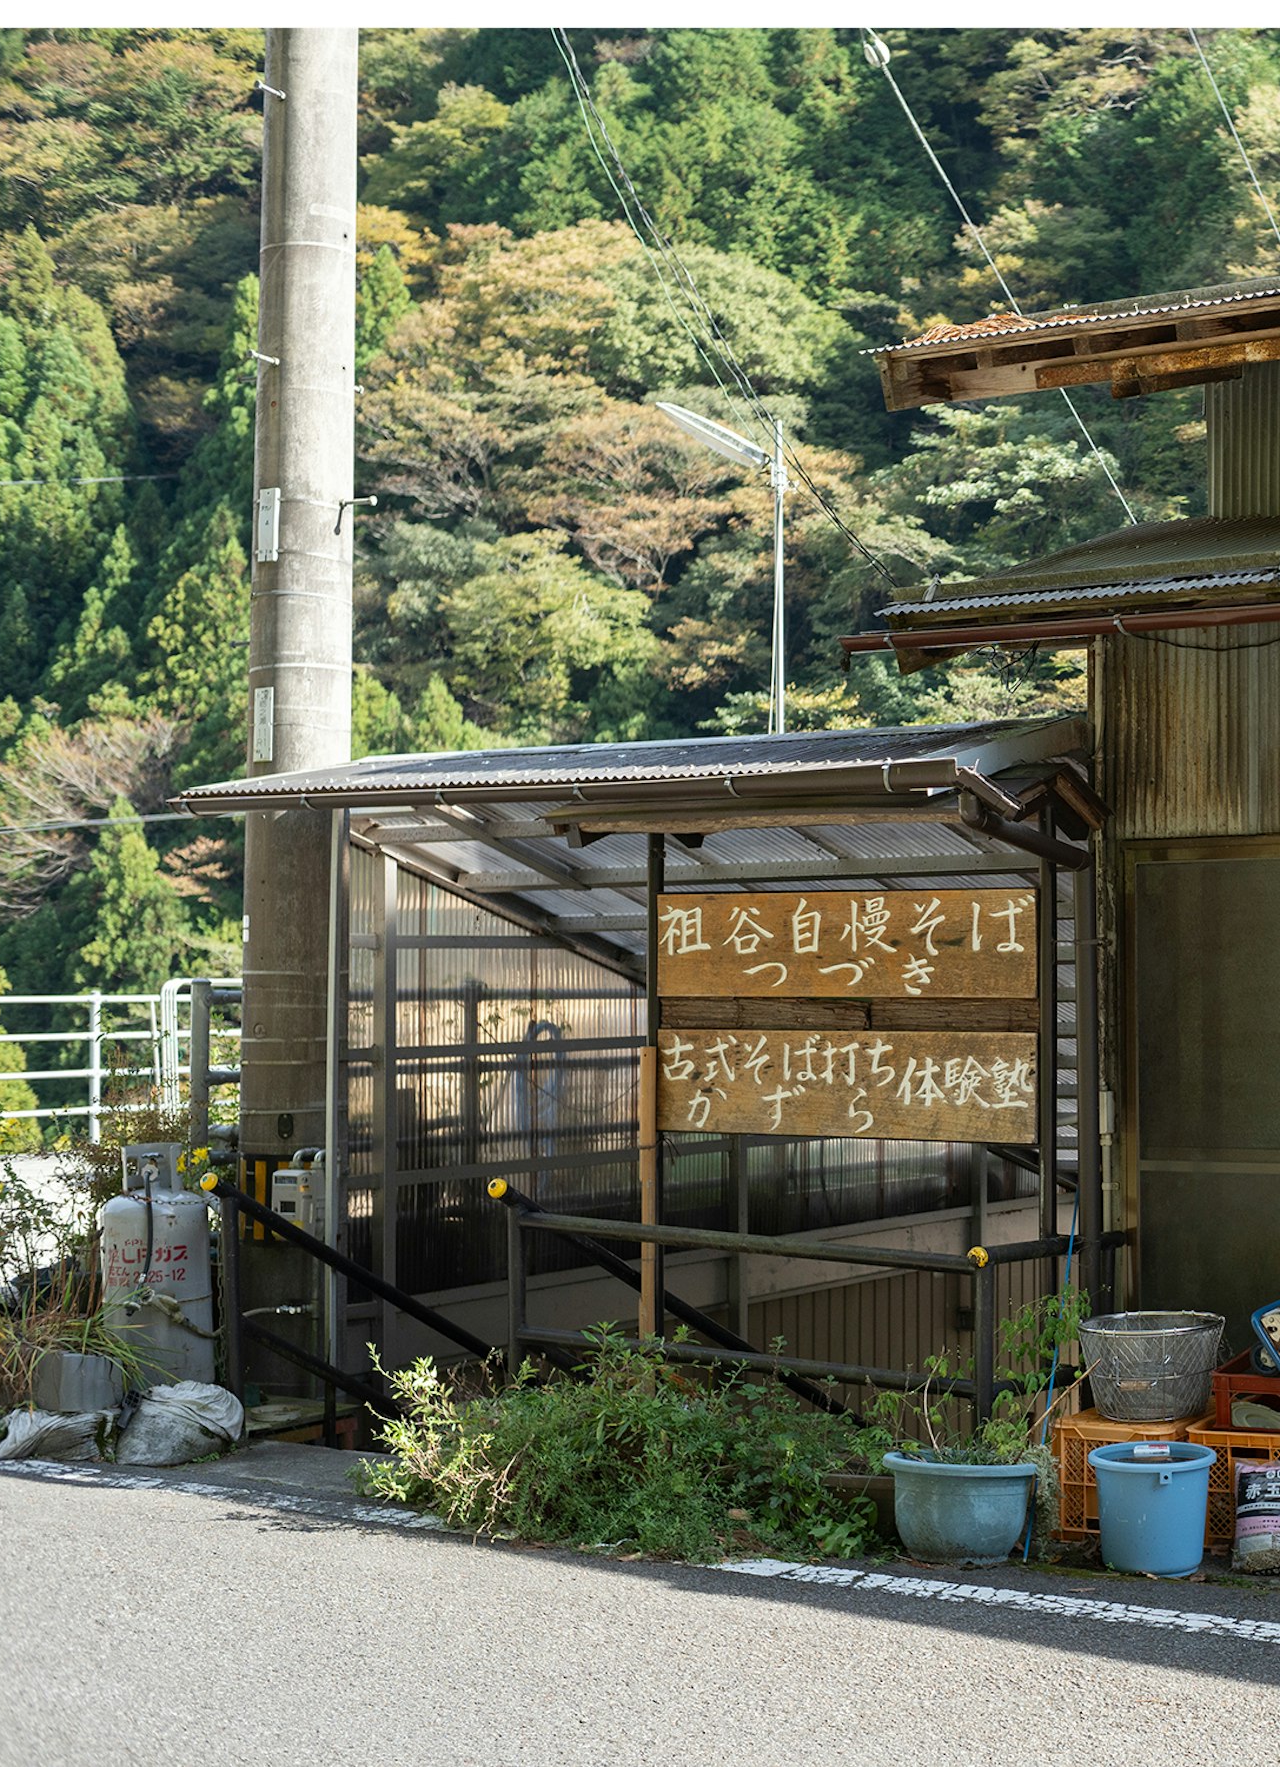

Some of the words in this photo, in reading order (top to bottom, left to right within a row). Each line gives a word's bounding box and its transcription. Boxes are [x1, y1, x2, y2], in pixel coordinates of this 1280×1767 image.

[659, 893, 1036, 956] 祖谷自慢そば
[742, 953, 935, 995] つづき
[686, 1084, 876, 1134] かずら
[133, 1268, 187, 1283] 225-12
